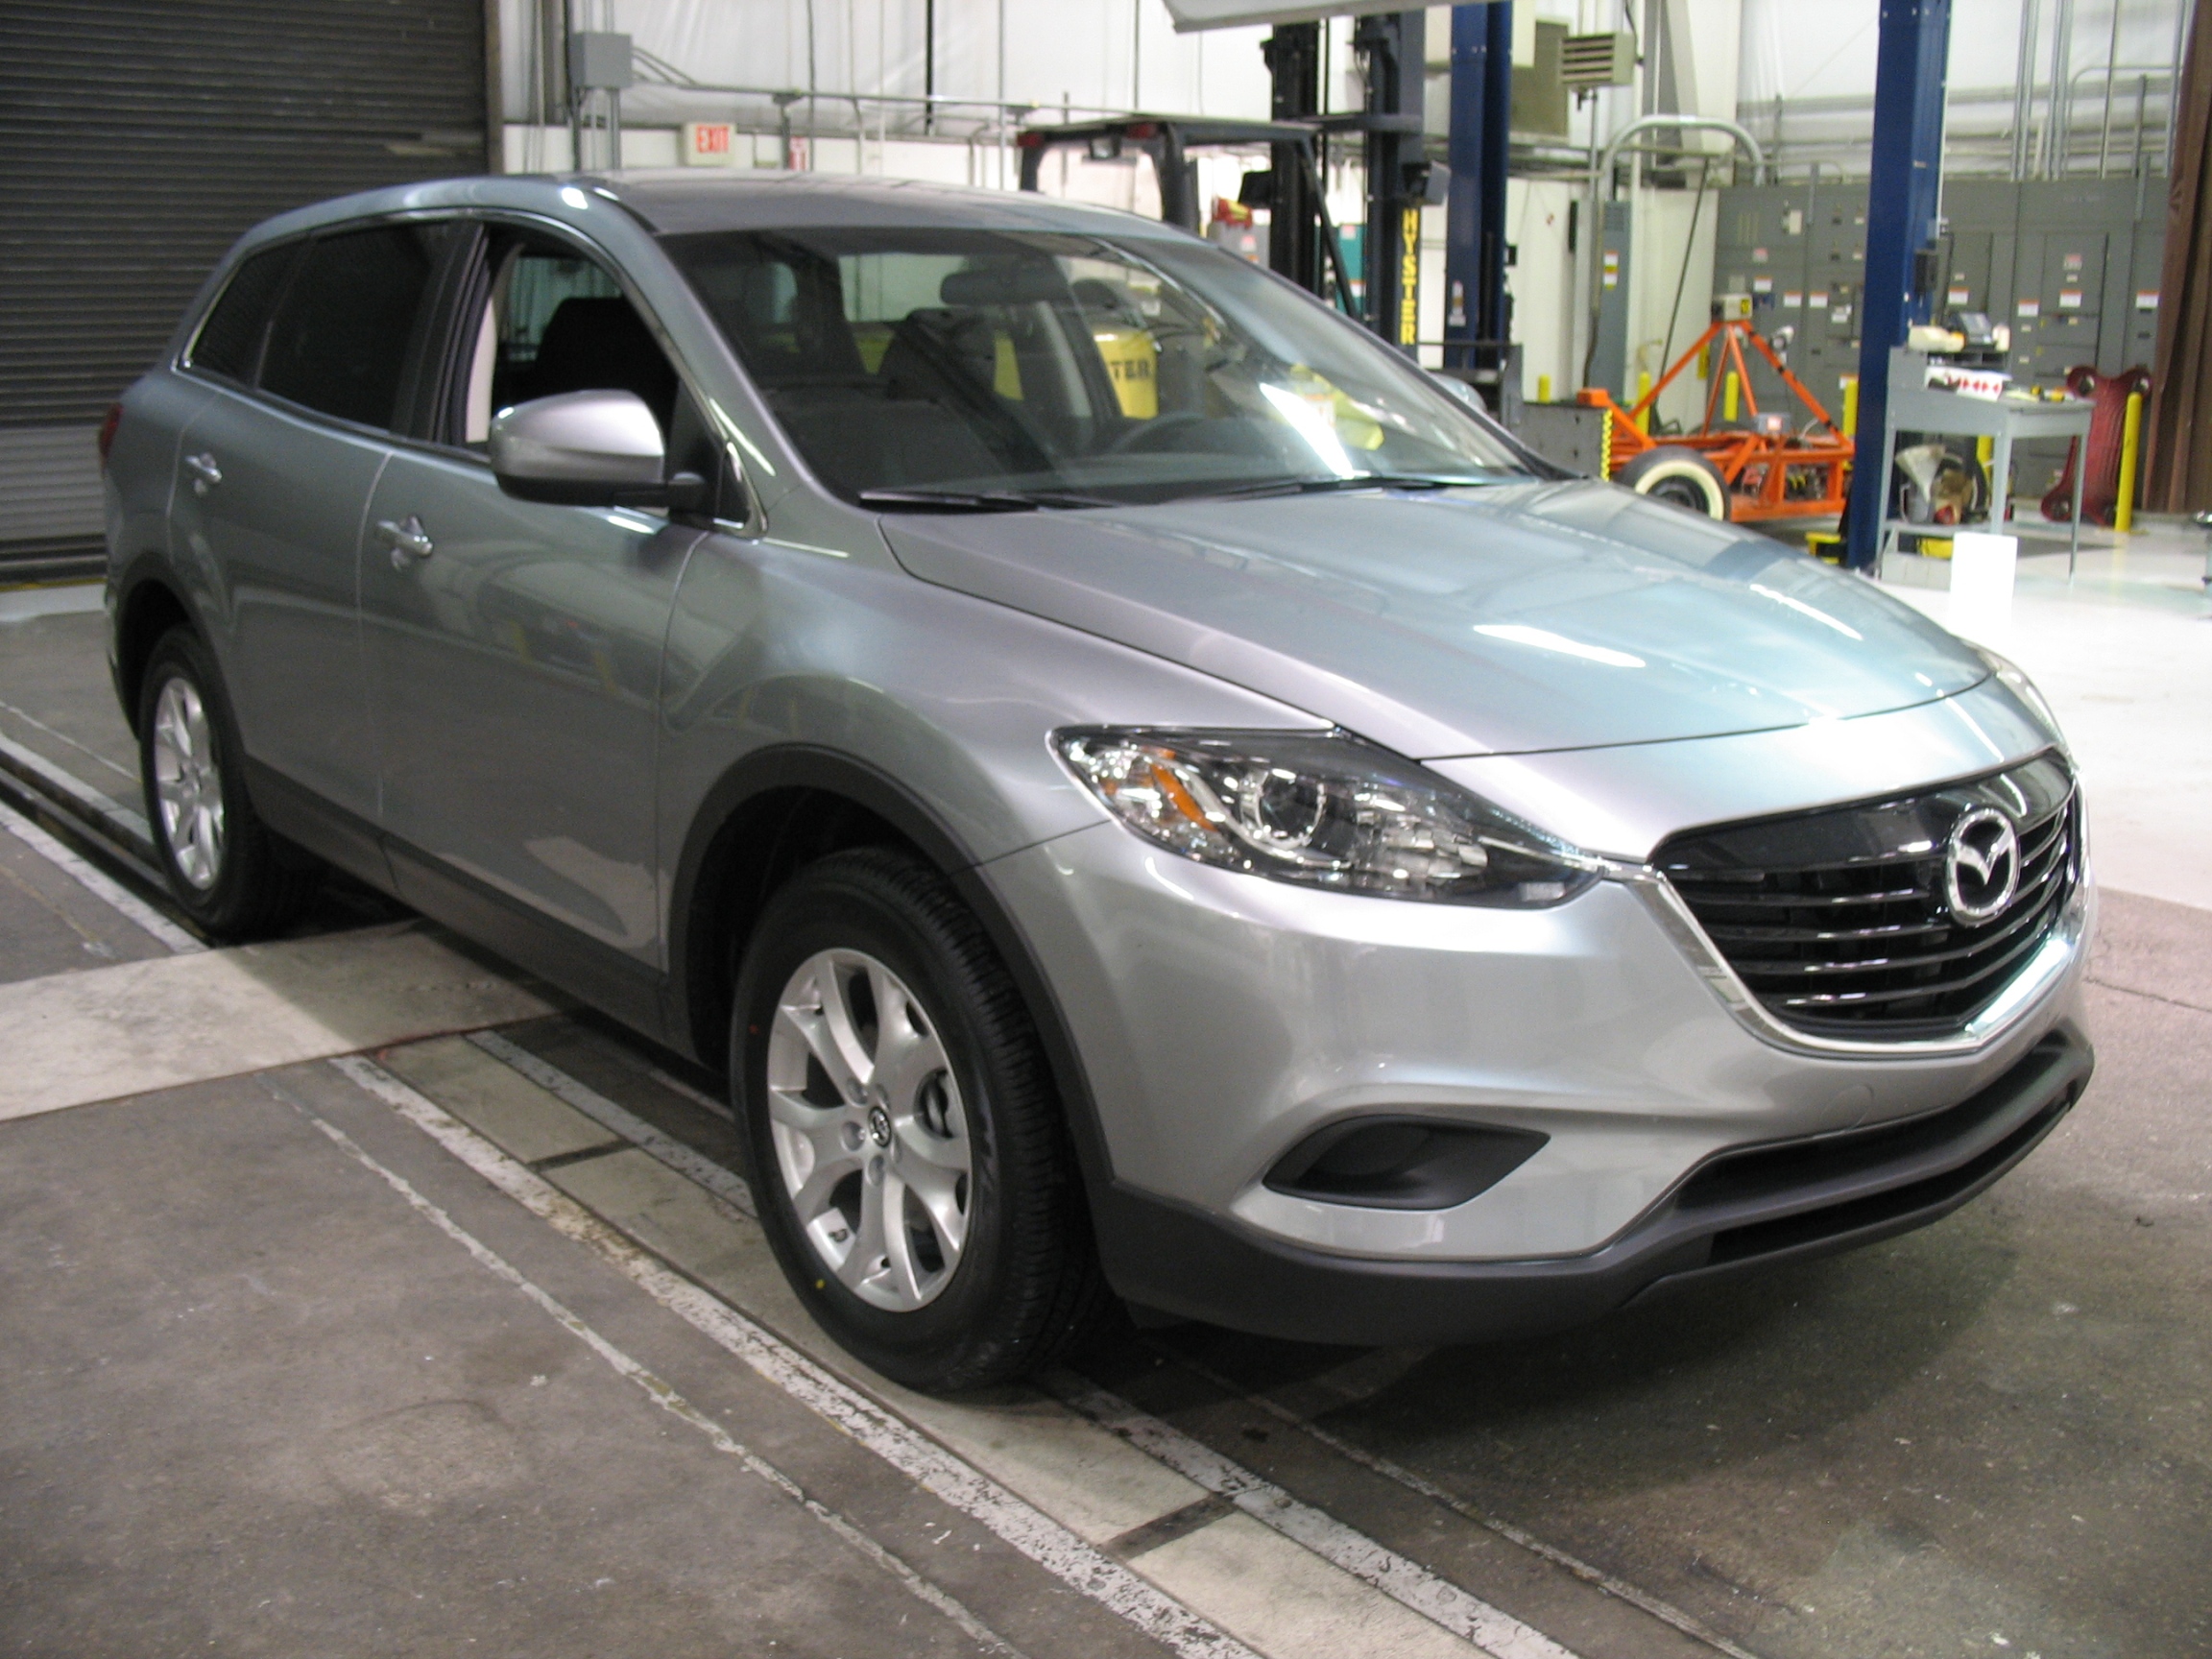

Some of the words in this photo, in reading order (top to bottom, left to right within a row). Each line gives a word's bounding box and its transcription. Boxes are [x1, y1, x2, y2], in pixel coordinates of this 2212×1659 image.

[696, 126, 730, 153] EXIT
[1401, 208, 1418, 345] HYSTER
[1110, 360, 1149, 380] TER
